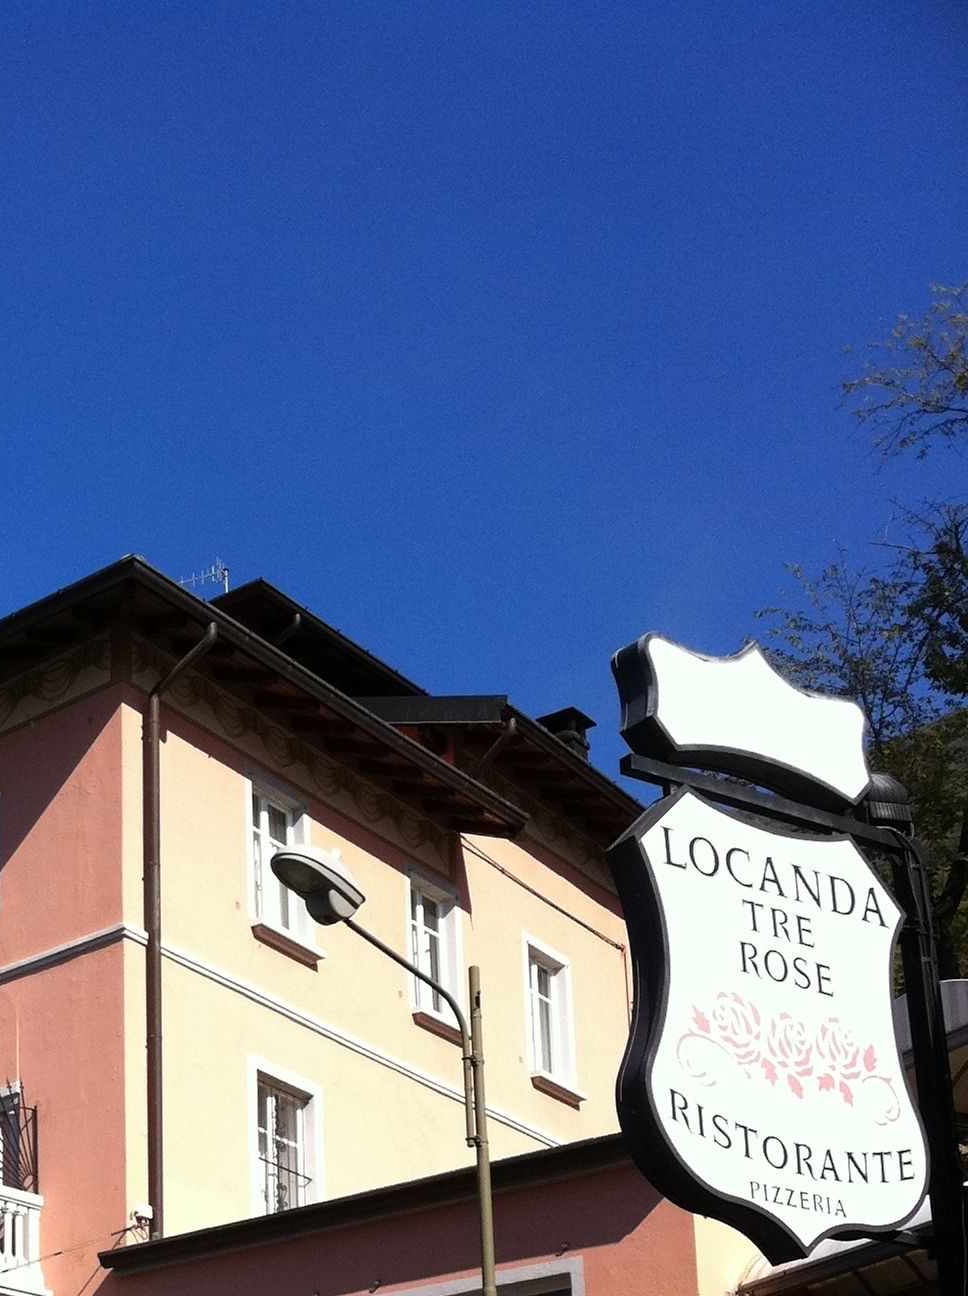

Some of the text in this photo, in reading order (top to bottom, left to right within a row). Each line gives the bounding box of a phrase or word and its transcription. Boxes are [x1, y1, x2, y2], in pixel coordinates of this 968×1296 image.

[661, 826, 890, 929] LOCANDA
[742, 899, 815, 948] TRE
[740, 941, 834, 998] ROSE
[669, 1088, 916, 1185] RISTORANTE
[749, 1181, 848, 1218] PIZZERIA
